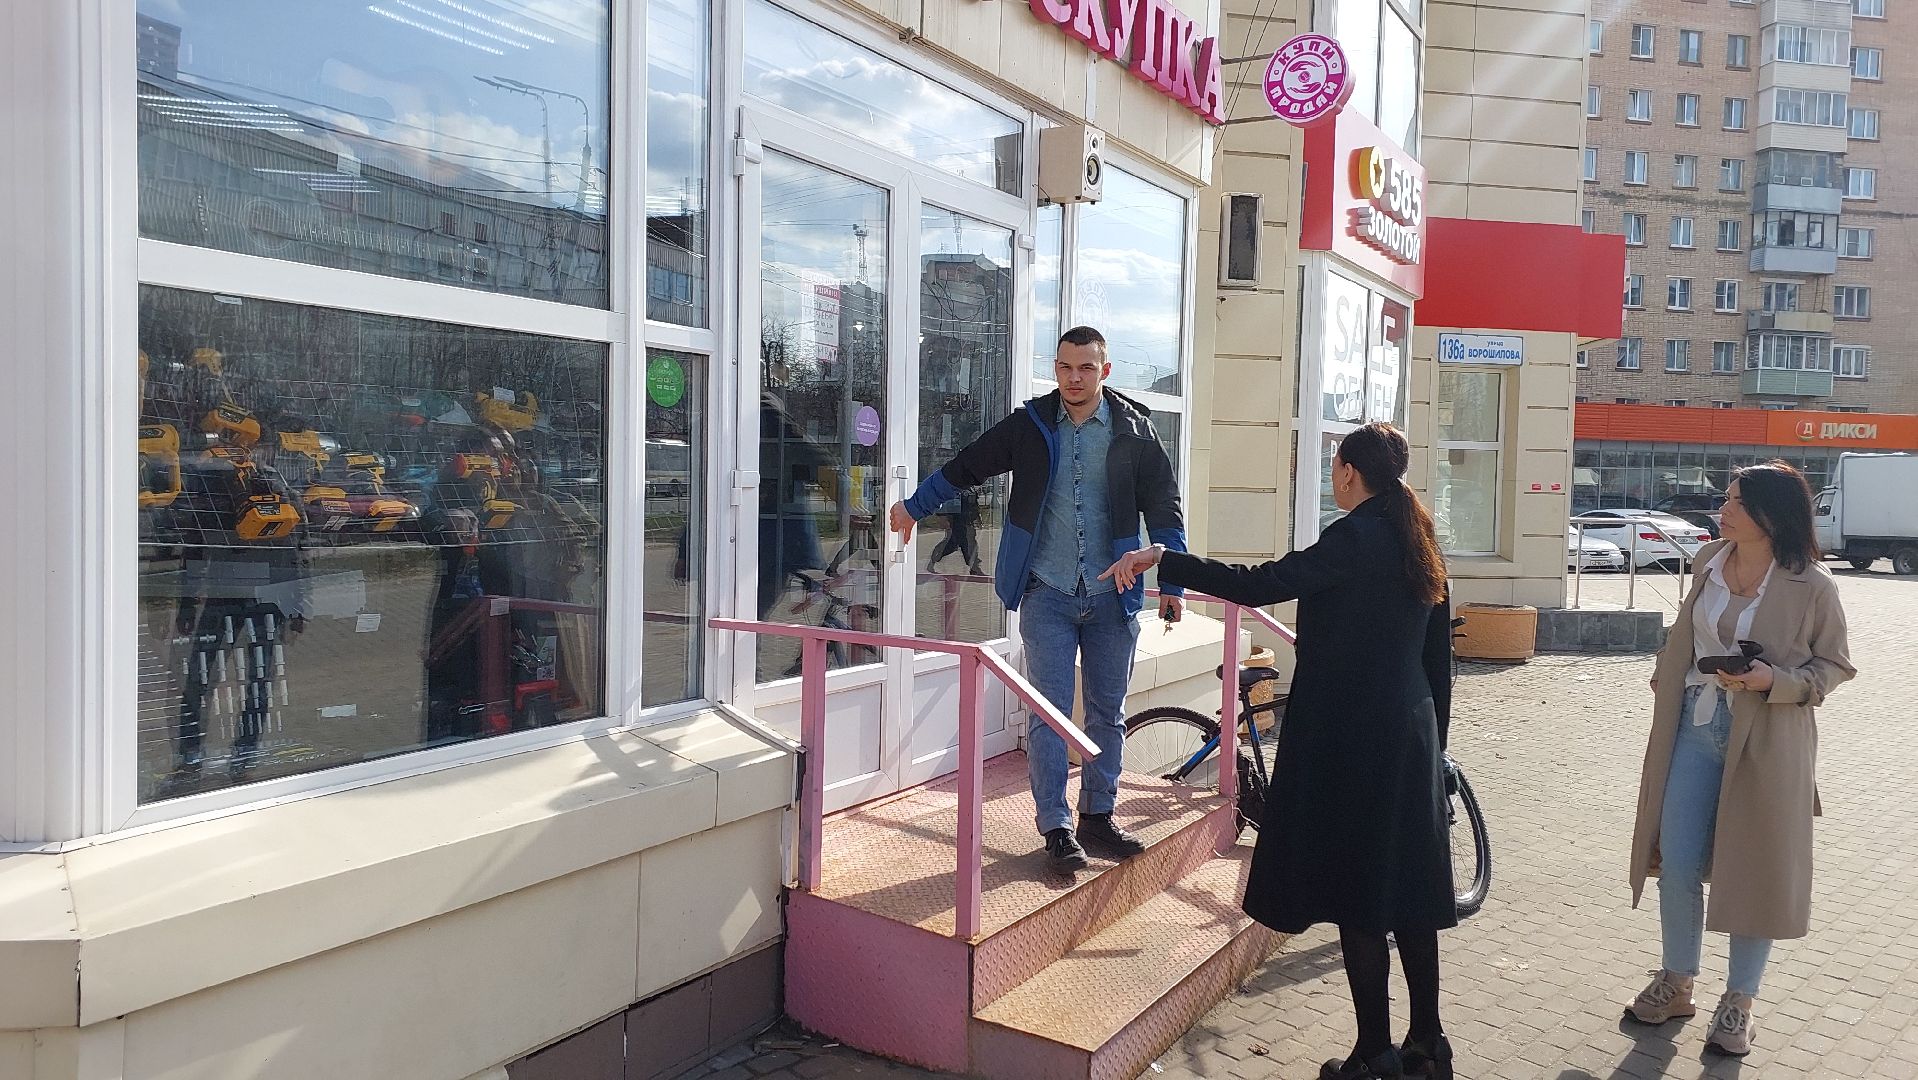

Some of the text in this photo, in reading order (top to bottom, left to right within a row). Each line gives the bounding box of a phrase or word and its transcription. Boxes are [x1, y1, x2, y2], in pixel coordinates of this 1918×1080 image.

[1041, 0, 1225, 124] УПКА
[1278, 41, 1335, 66] КУПИ
[1270, 81, 1338, 114] ПРОДАЙ
[1389, 158, 1422, 226] 585
[1367, 206, 1420, 265] ЗОЛОТОЙ
[1468, 348, 1520, 359] ВОРОШИЛОВА
[1820, 422, 1877, 440] ДИКСИ
